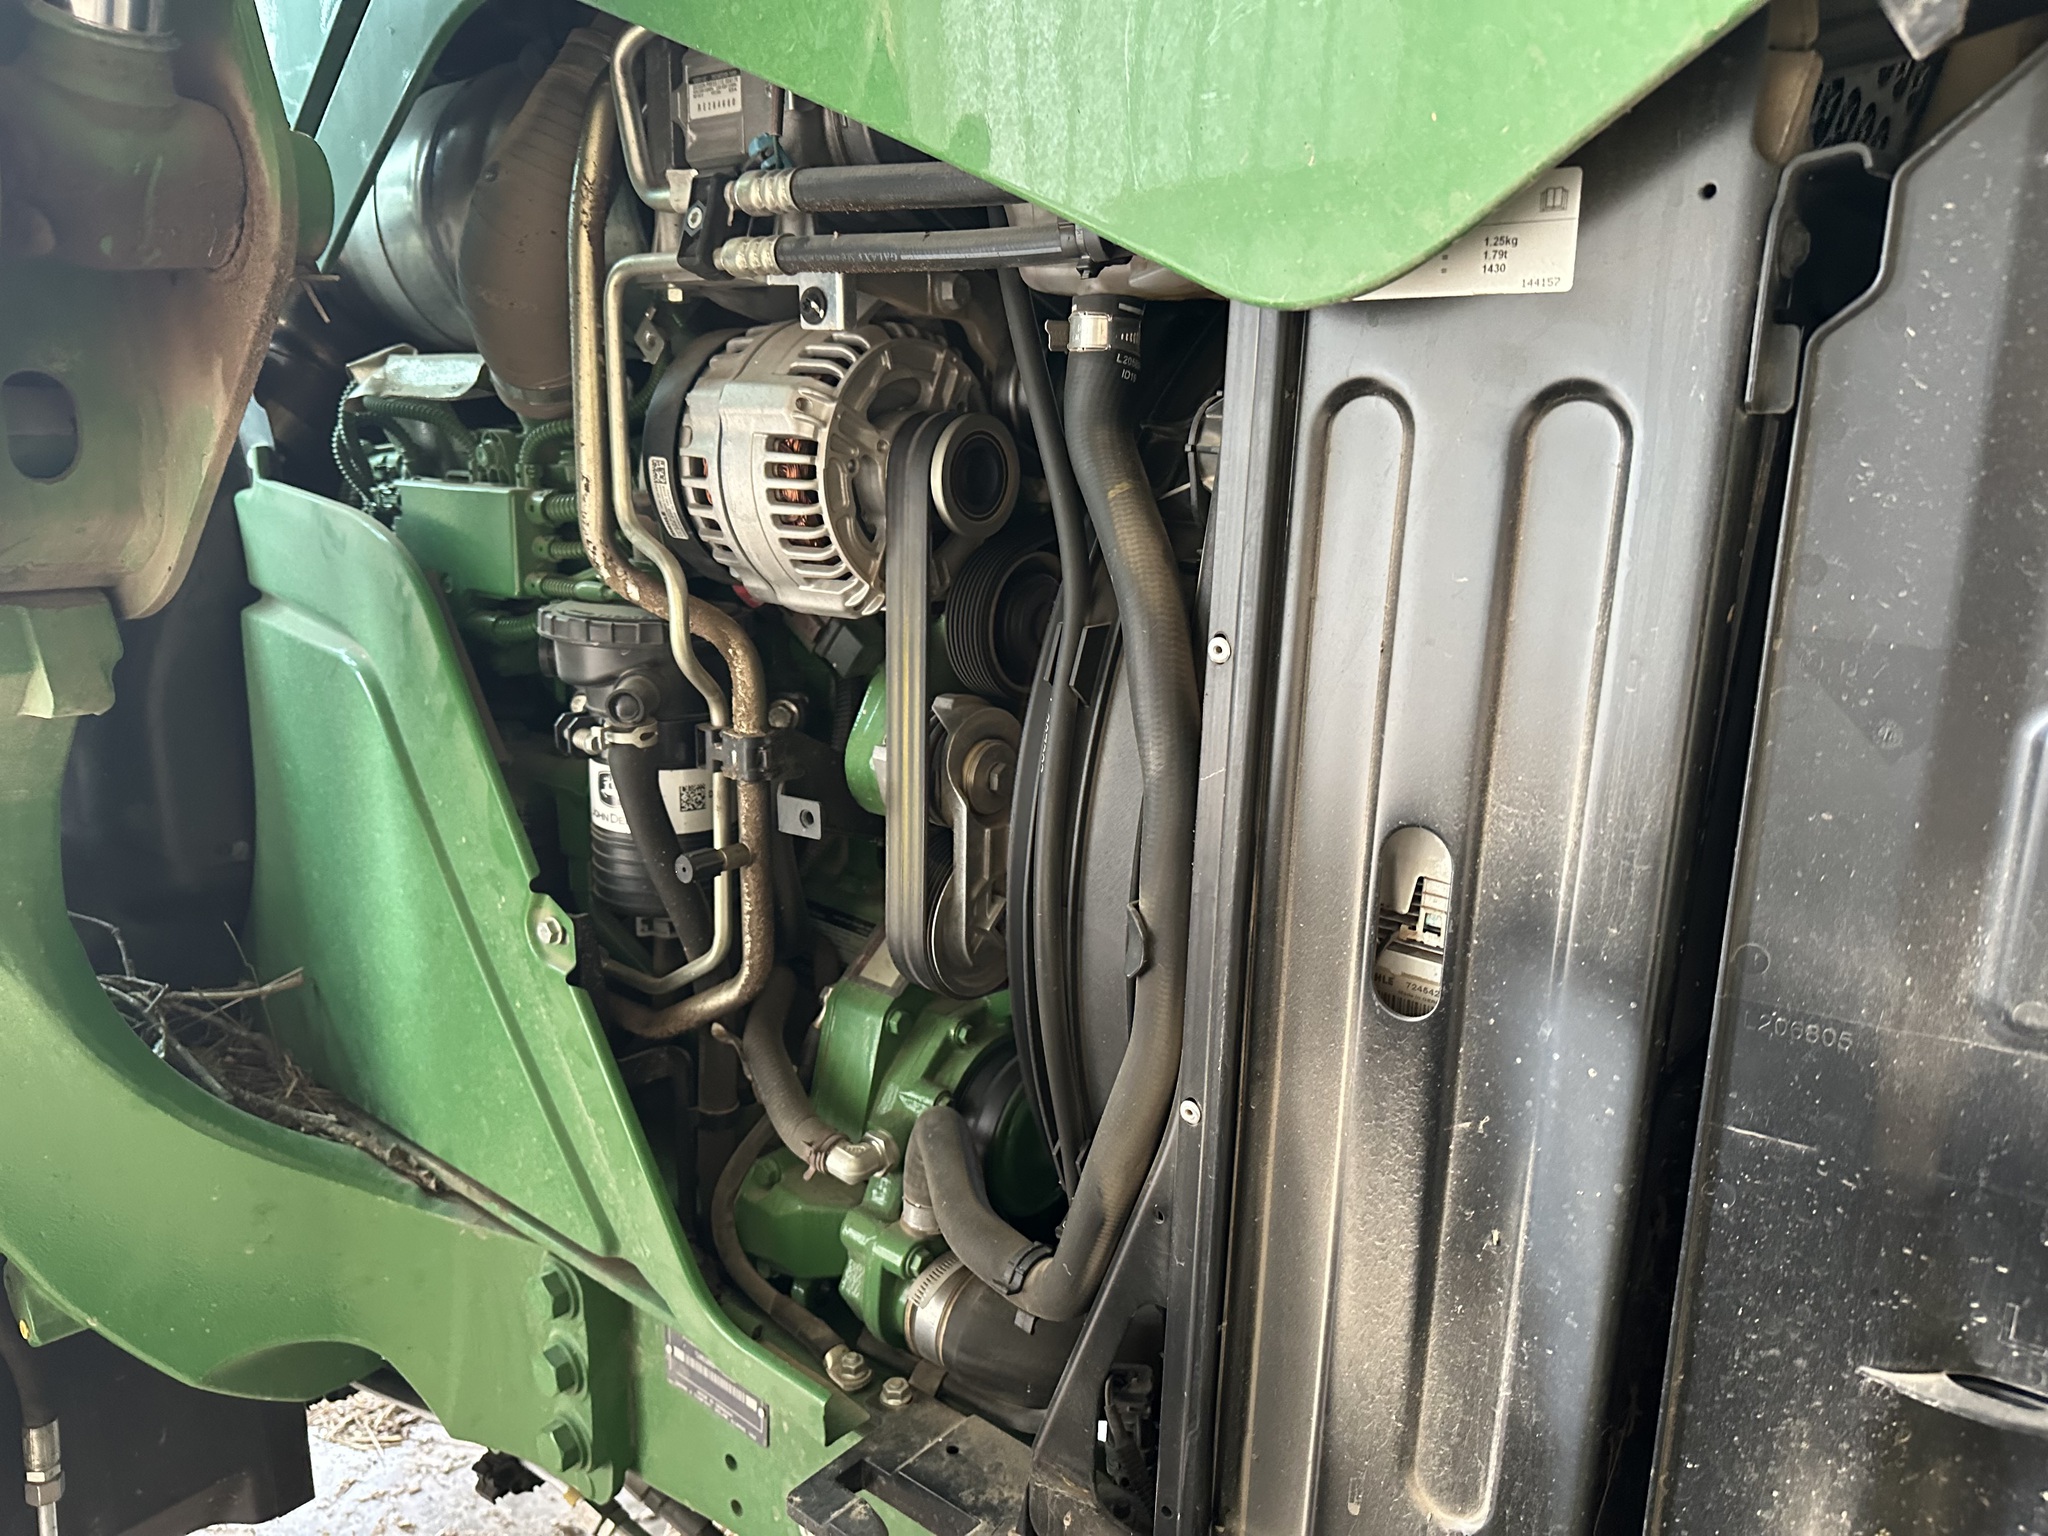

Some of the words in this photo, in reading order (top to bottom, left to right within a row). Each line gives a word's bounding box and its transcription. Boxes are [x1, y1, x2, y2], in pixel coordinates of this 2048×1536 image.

[1484, 236, 1519, 248] 1.25kg
[1483, 250, 1508, 260] 1.79t
[1482, 264, 1507, 274] 1430
[1374, 973, 1394, 985] HLE
